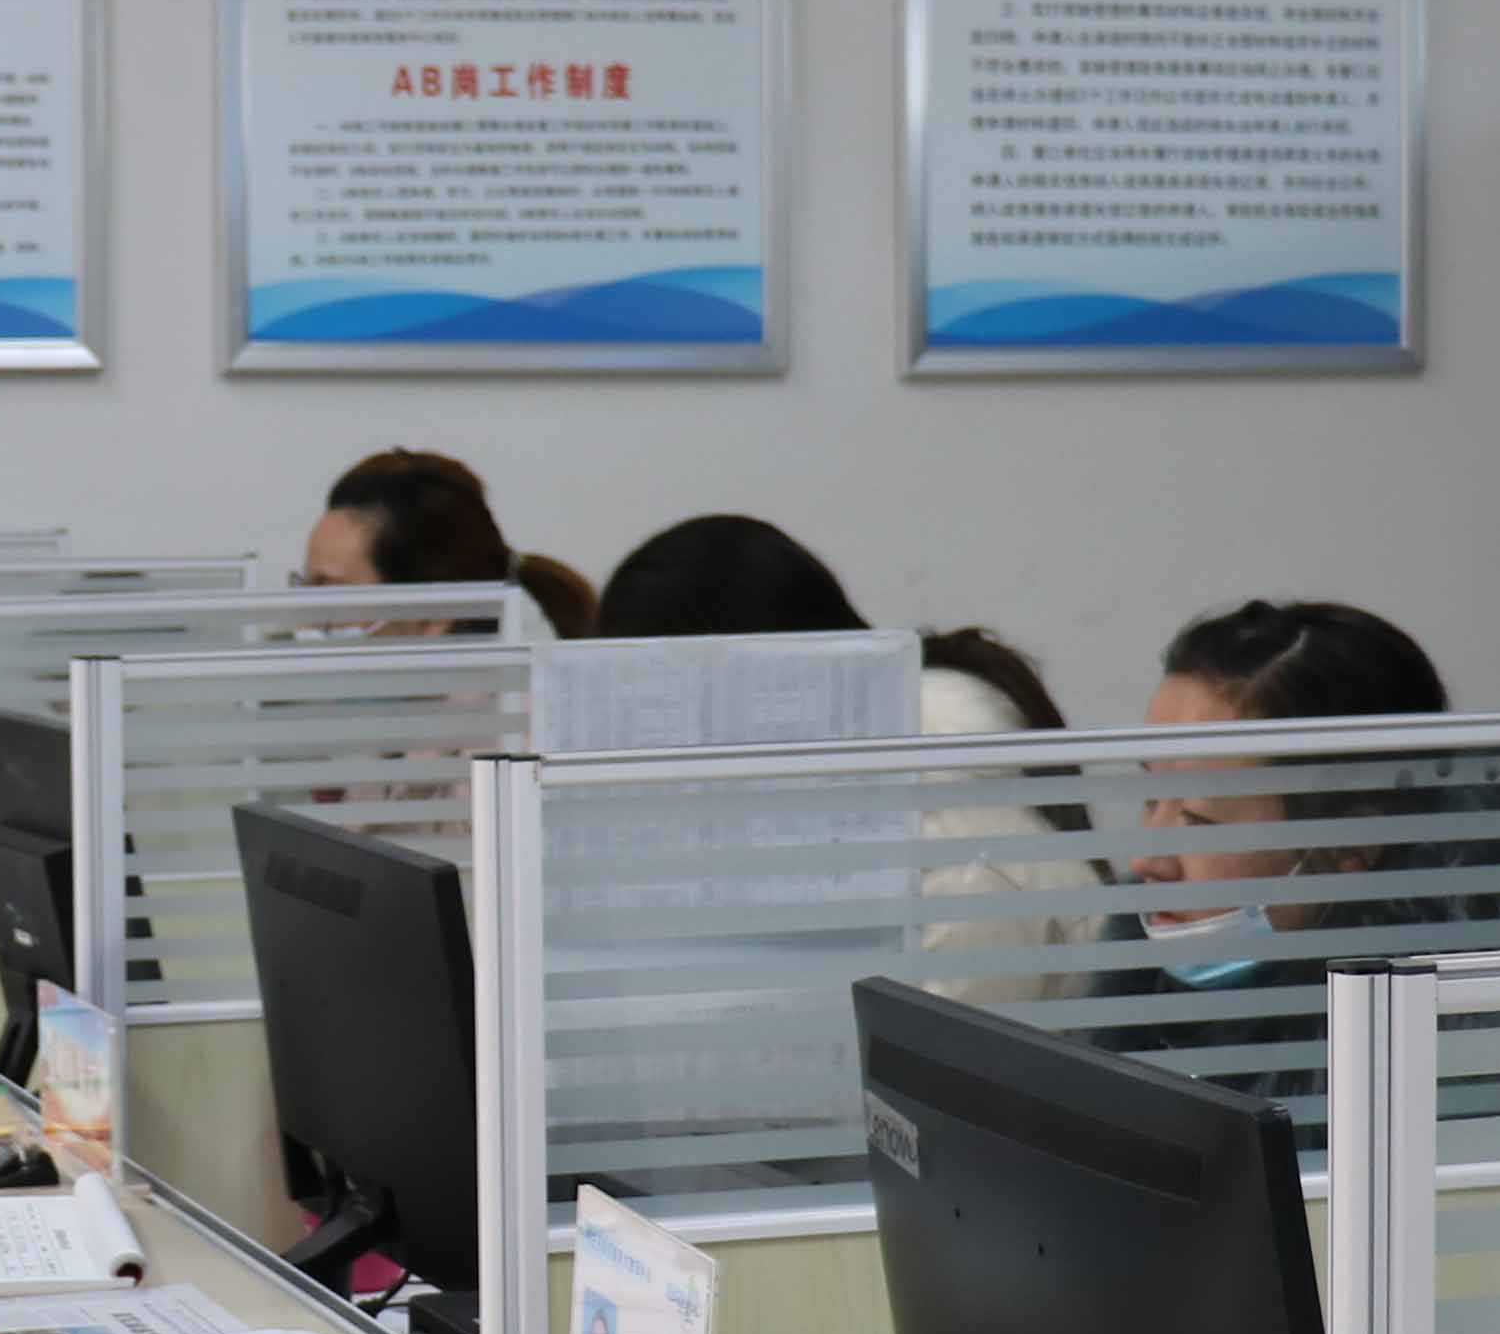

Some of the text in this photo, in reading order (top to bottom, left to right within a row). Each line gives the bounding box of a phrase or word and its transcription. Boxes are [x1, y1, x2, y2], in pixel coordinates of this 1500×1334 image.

[392, 62, 631, 100] AB岗工作制度
